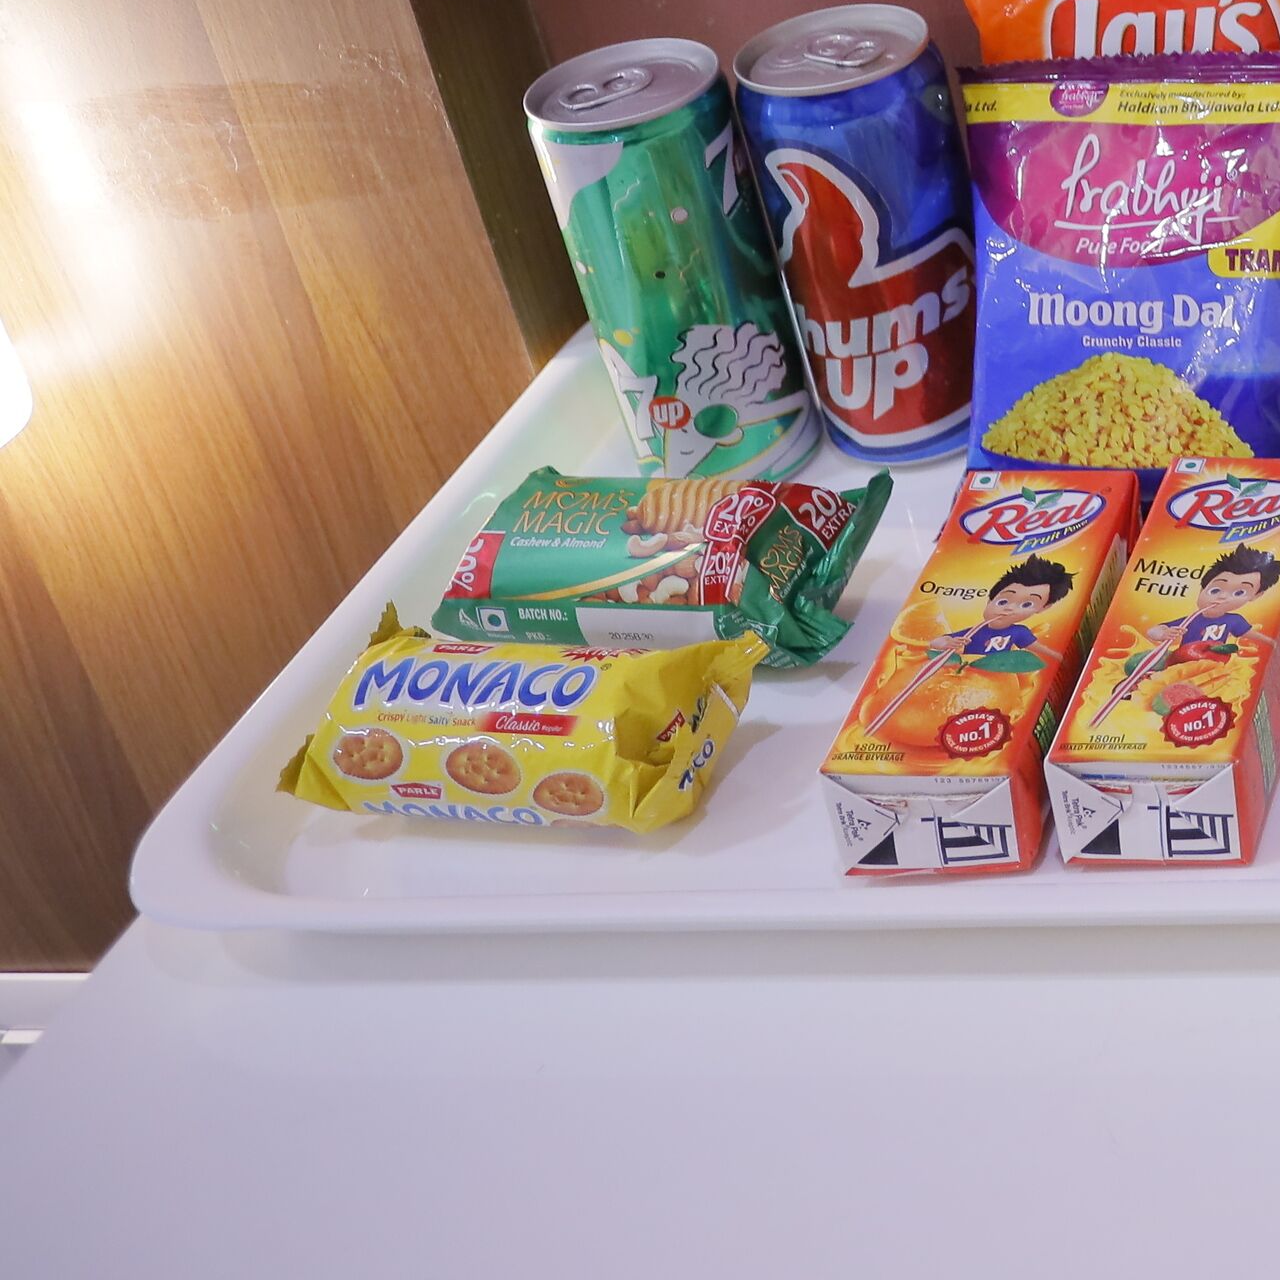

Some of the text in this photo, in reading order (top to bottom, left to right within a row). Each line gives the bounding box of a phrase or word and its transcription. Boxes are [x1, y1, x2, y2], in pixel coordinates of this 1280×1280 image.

[794, 265, 971, 358] hums
[1028, 291, 1236, 335] Moong Dal
[1081, 335, 1183, 350] Crunchy Classic
[512, 510, 620, 535] MAGIC
[967, 491, 1098, 545] Real
[1225, 521, 1269, 541] Fruit
[510, 536, 606, 549] Cashew & Almond
[1016, 531, 1061, 553] Fruit
[1133, 557, 1206, 581] Mixed
[919, 579, 989, 601] Orange
[1133, 577, 1190, 599] Fruit
[518, 607, 547, 621] BATCH
[353, 656, 598, 708] MONACO
[1178, 702, 1218, 716] INDIA'S
[495, 715, 541, 733] Classic
[955, 713, 996, 726] INDIA'S
[1183, 710, 1215, 733] NO.1
[959, 721, 991, 743] NO.1
[1088, 734, 1126, 744] 180ml
[831, 752, 906, 762] ORANGE BEVERAGE
[854, 742, 891, 753] 180ml
[1109, 743, 1148, 751] BEVERAGE
[398, 786, 439, 797] PARLE
